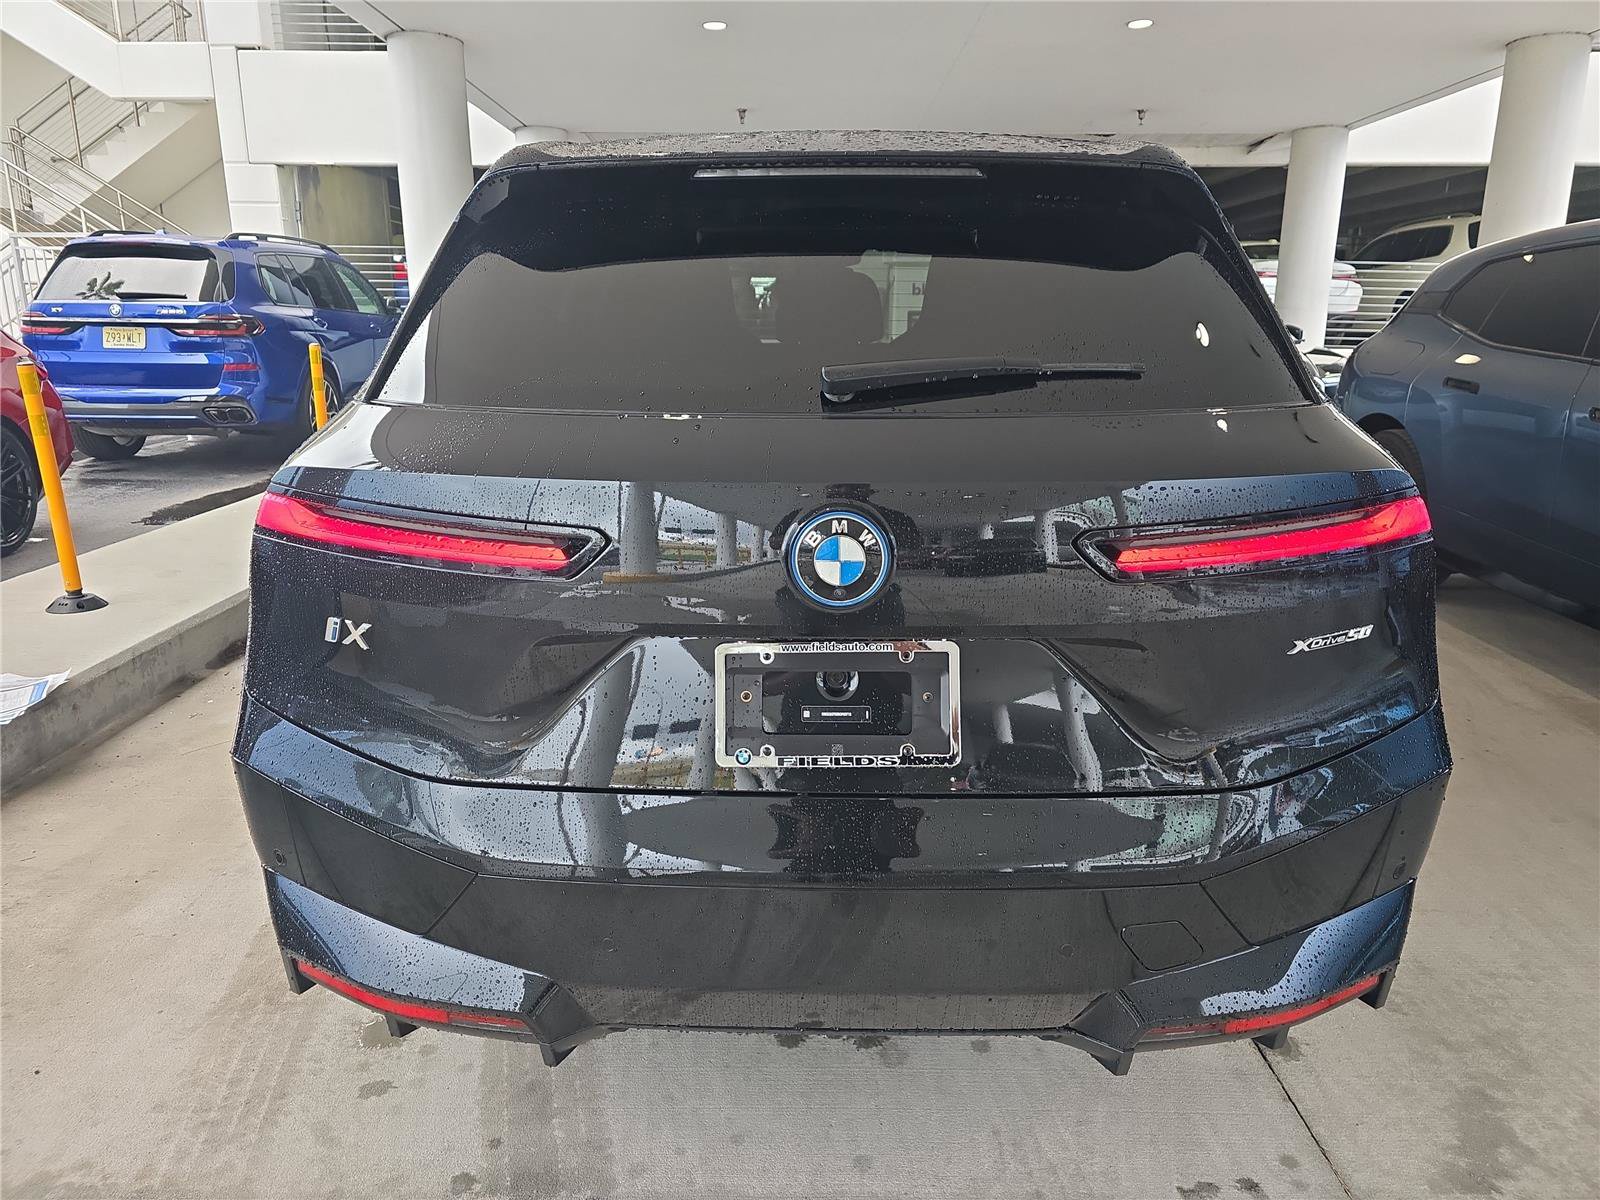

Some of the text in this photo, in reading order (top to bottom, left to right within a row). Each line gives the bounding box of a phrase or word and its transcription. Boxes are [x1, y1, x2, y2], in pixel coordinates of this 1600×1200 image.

[803, 519, 877, 548] BMW
[780, 641, 894, 653] www.fieldsauto.com
[777, 755, 900, 767] FIELDS
